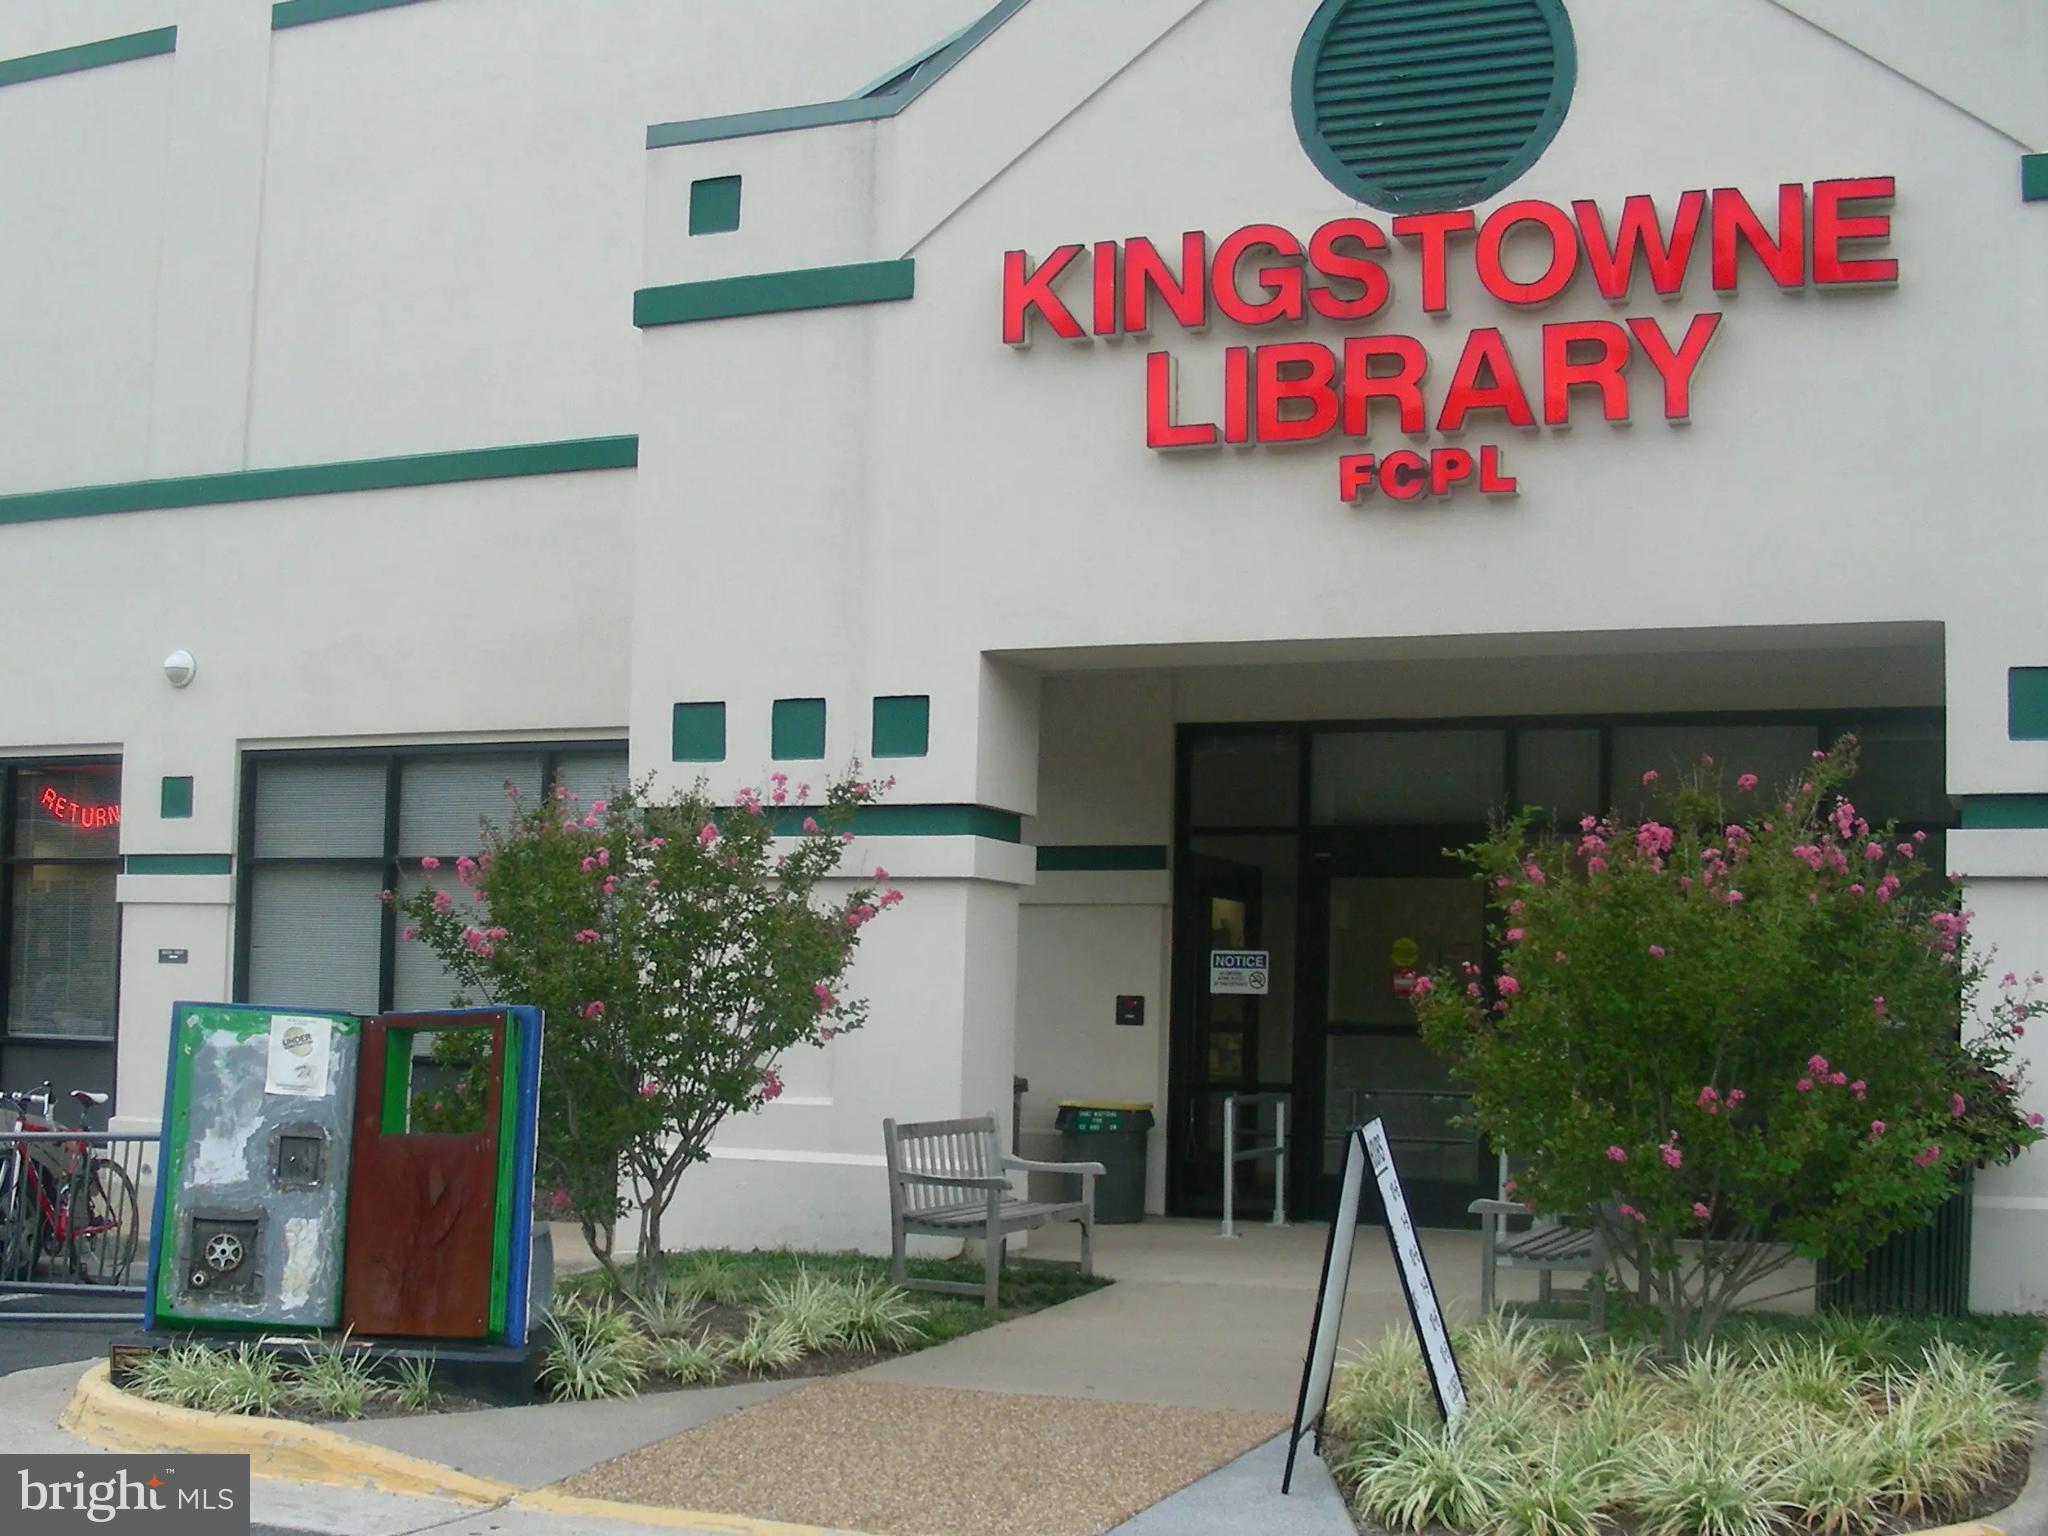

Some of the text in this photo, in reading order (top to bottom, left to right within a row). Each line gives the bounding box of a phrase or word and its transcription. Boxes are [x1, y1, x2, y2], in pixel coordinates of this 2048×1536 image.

[1002, 176, 1899, 345] KINGSTOWNE
[1146, 312, 1723, 449] LIBRARY
[1339, 444, 1519, 503] FCPL
[41, 787, 120, 828] RETURN
[1215, 955, 1265, 968] NOTICE
[282, 1032, 313, 1047] UNDER
